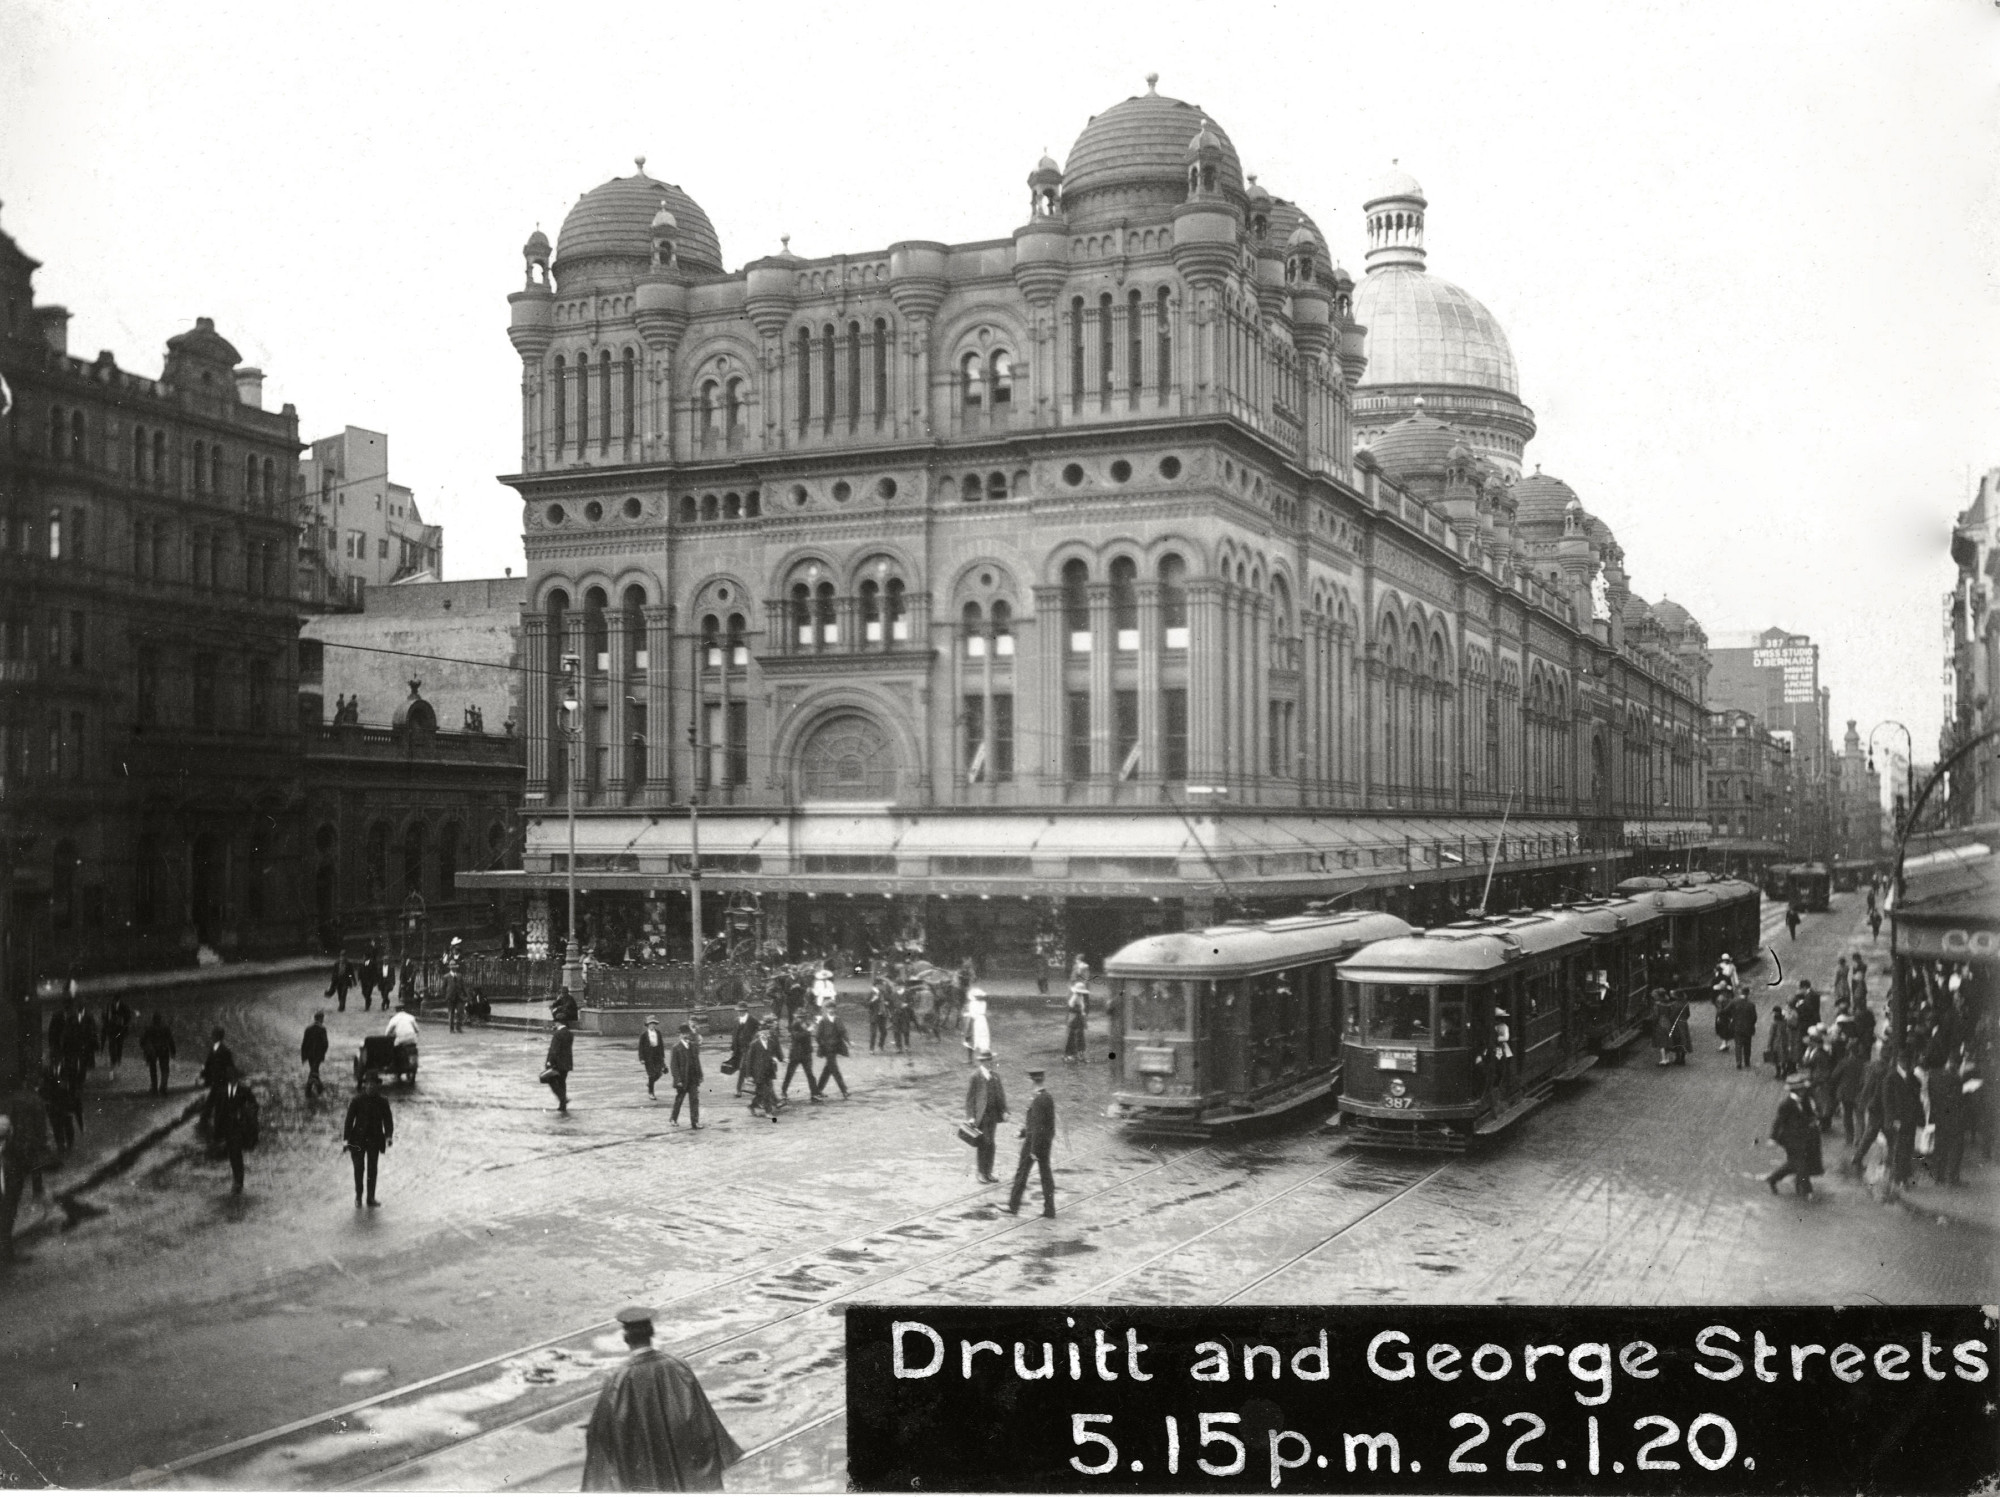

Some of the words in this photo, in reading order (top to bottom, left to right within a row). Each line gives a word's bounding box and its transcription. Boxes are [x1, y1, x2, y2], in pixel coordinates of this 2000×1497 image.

[1753, 649, 1781, 658] SWISS
[1782, 647, 1813, 657] STUDIO
[875, 880, 915, 891] OF
[929, 881, 993, 892] LOW
[1025, 882, 1140, 894] PRICES
[1385, 1097, 1412, 1109] 387
